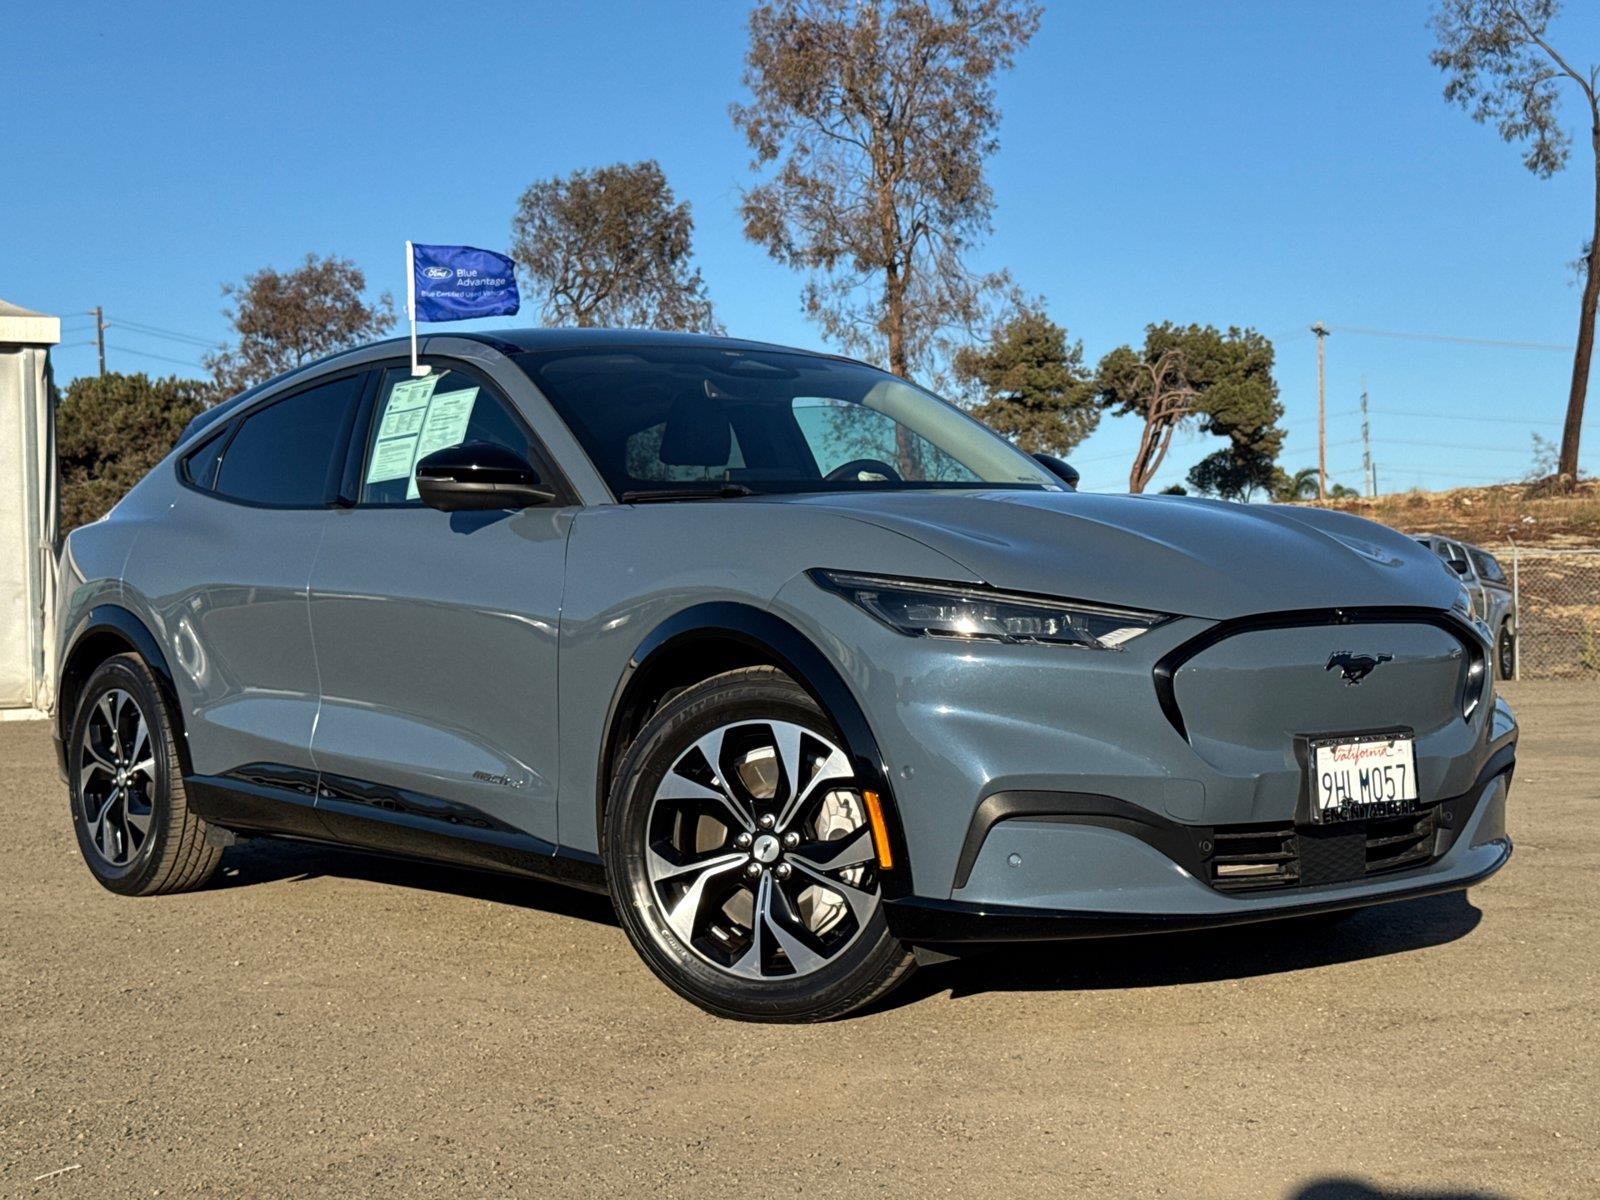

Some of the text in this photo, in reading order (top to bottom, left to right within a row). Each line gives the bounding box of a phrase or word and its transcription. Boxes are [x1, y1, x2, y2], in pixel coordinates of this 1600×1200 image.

[456, 269, 478, 278] Blue
[456, 278, 506, 288] Advantage
[421, 290, 436, 298] Blue
[436, 290, 465, 298] Certified
[1333, 743, 1389, 766] California
